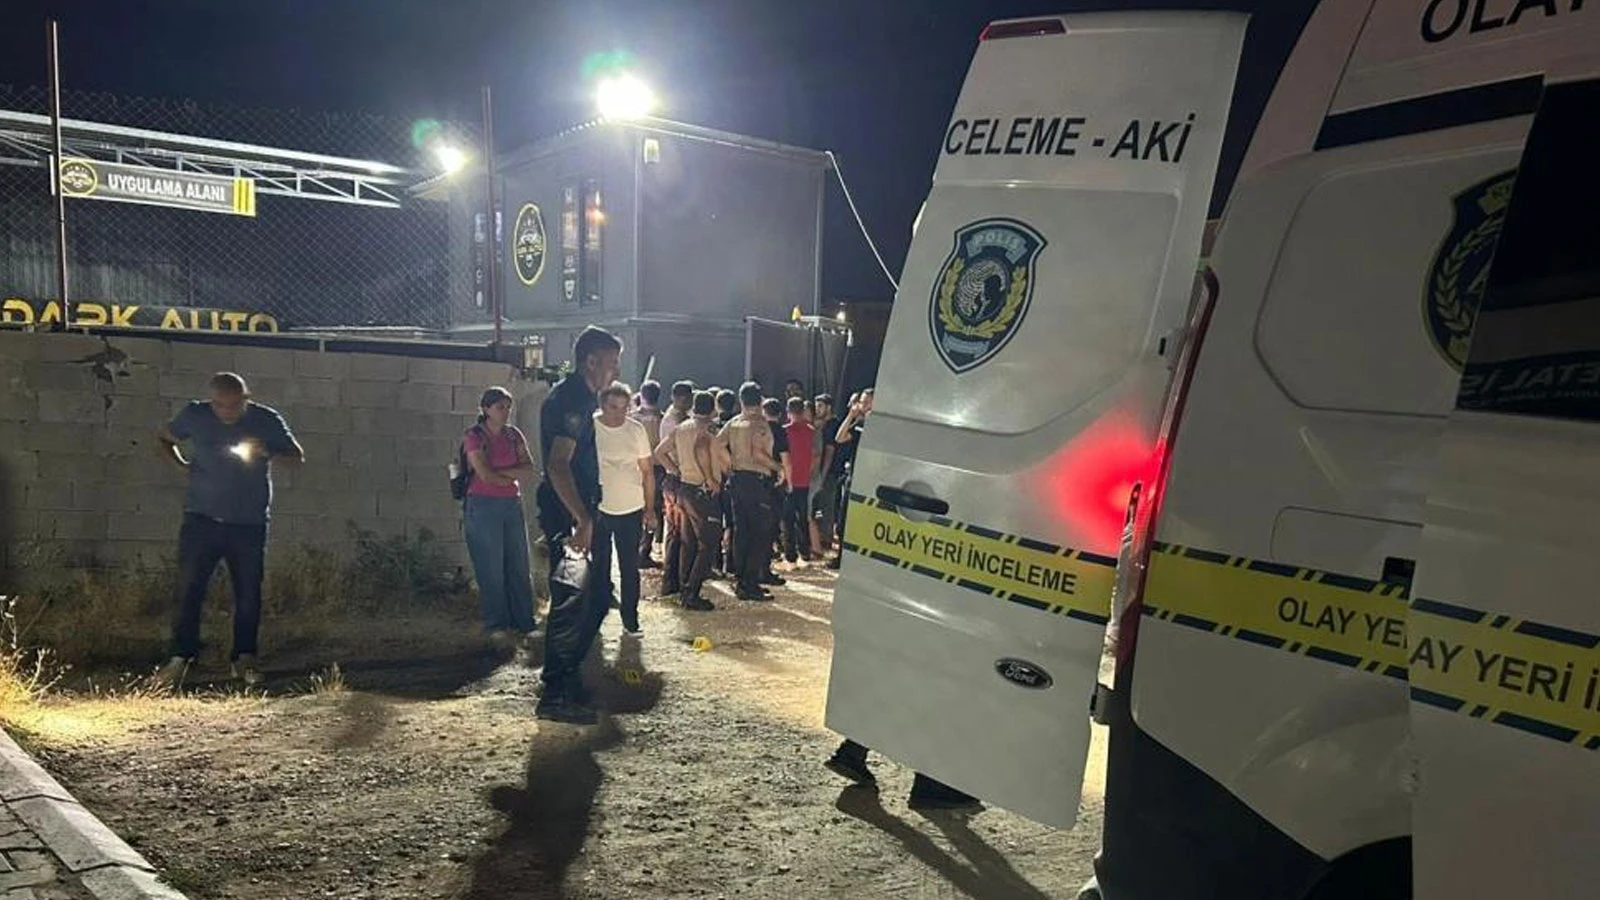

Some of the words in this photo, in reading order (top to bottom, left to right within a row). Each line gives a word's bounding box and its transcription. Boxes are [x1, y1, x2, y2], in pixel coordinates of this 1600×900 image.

[944, 117, 1086, 156] CELEME
[1110, 112, 1196, 164] AKİ
[107, 172, 184, 199] UYGULAMA
[185, 182, 227, 202] ALANI
[160, 307, 279, 333] AUTO
[873, 521, 918, 551] OLAY
[921, 535, 964, 565] YERİ
[966, 546, 1078, 595] İNCELEME
[1277, 596, 1356, 635] OLAY
[1363, 613, 1408, 650] YE
[1004, 661, 1039, 685] Ford
[1474, 648, 1574, 703] YERİ
